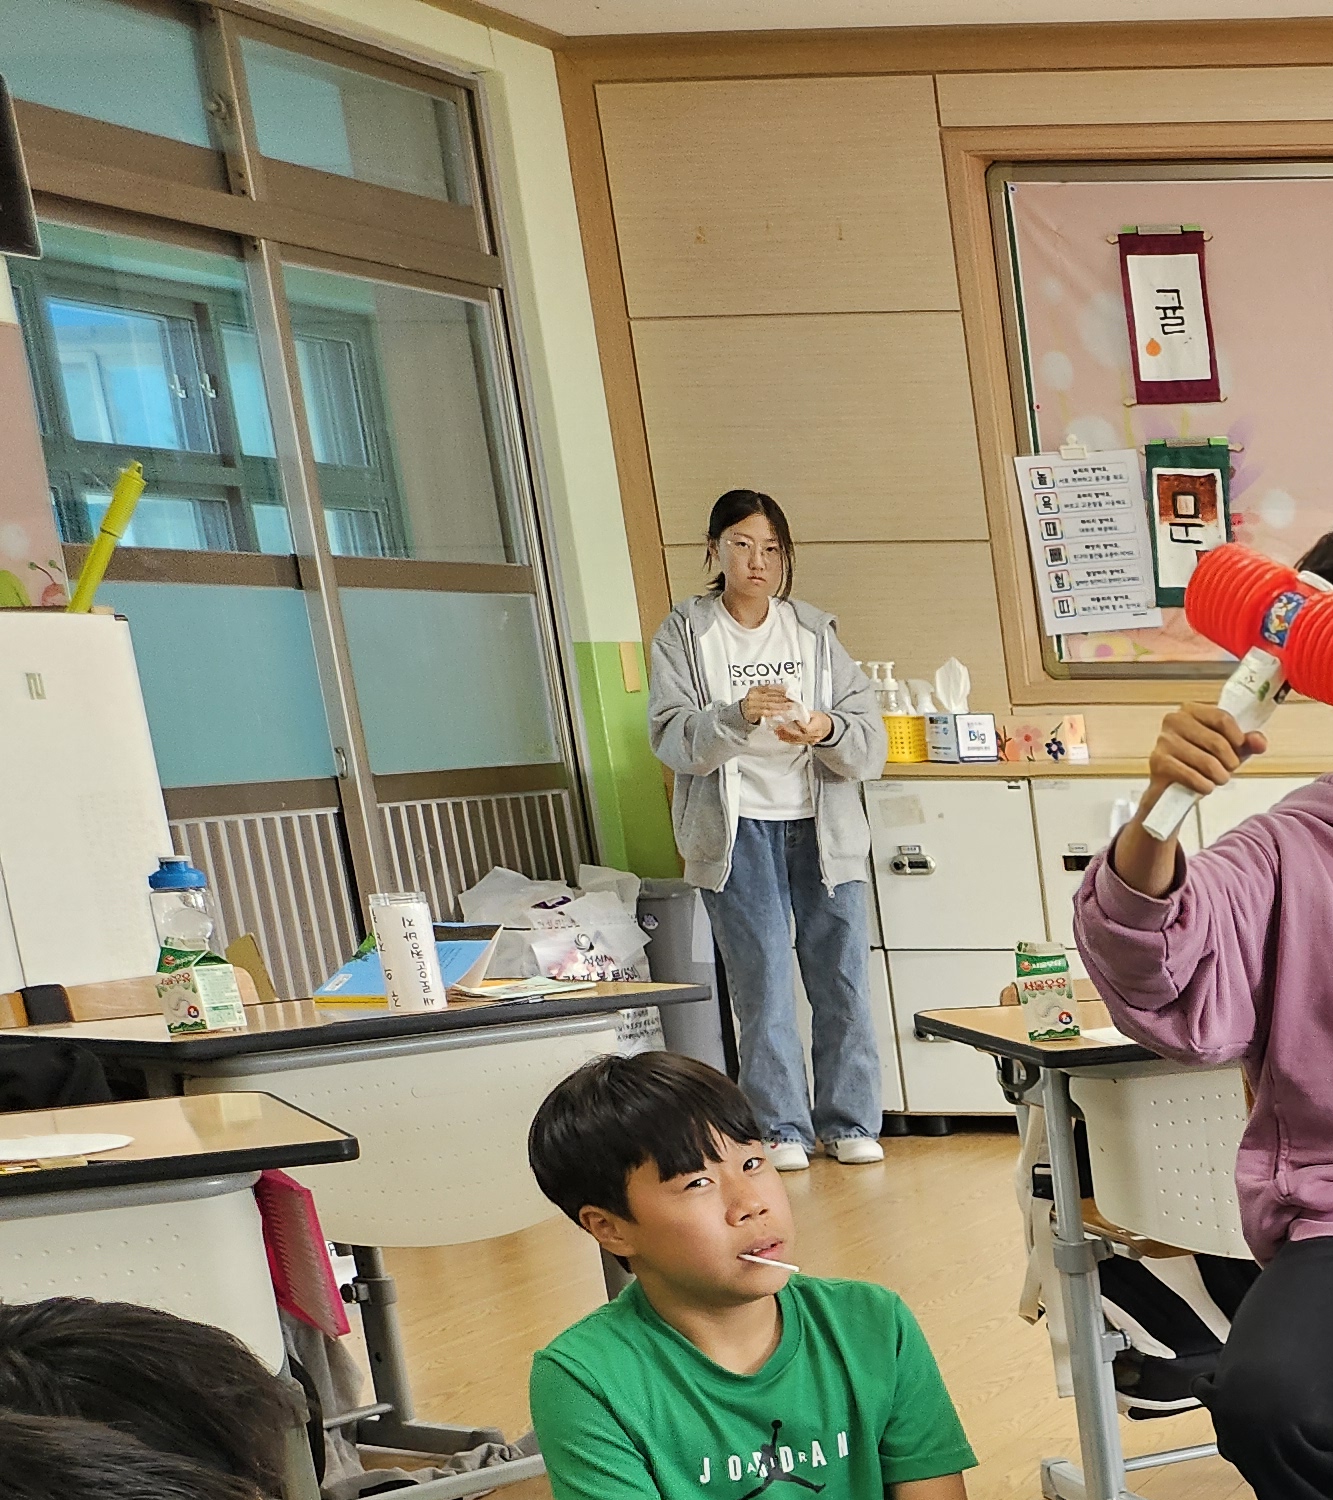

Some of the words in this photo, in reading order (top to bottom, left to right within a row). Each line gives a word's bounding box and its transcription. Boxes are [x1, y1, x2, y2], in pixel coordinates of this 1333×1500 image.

[1154, 288, 1186, 336] 귤
[1168, 490, 1206, 545] 문
[727, 660, 804, 678] iscover
[732, 677, 785, 687] EXPEDIT
[1023, 977, 1067, 992] 서울우유
[699, 1430, 849, 1484] JORDAN
